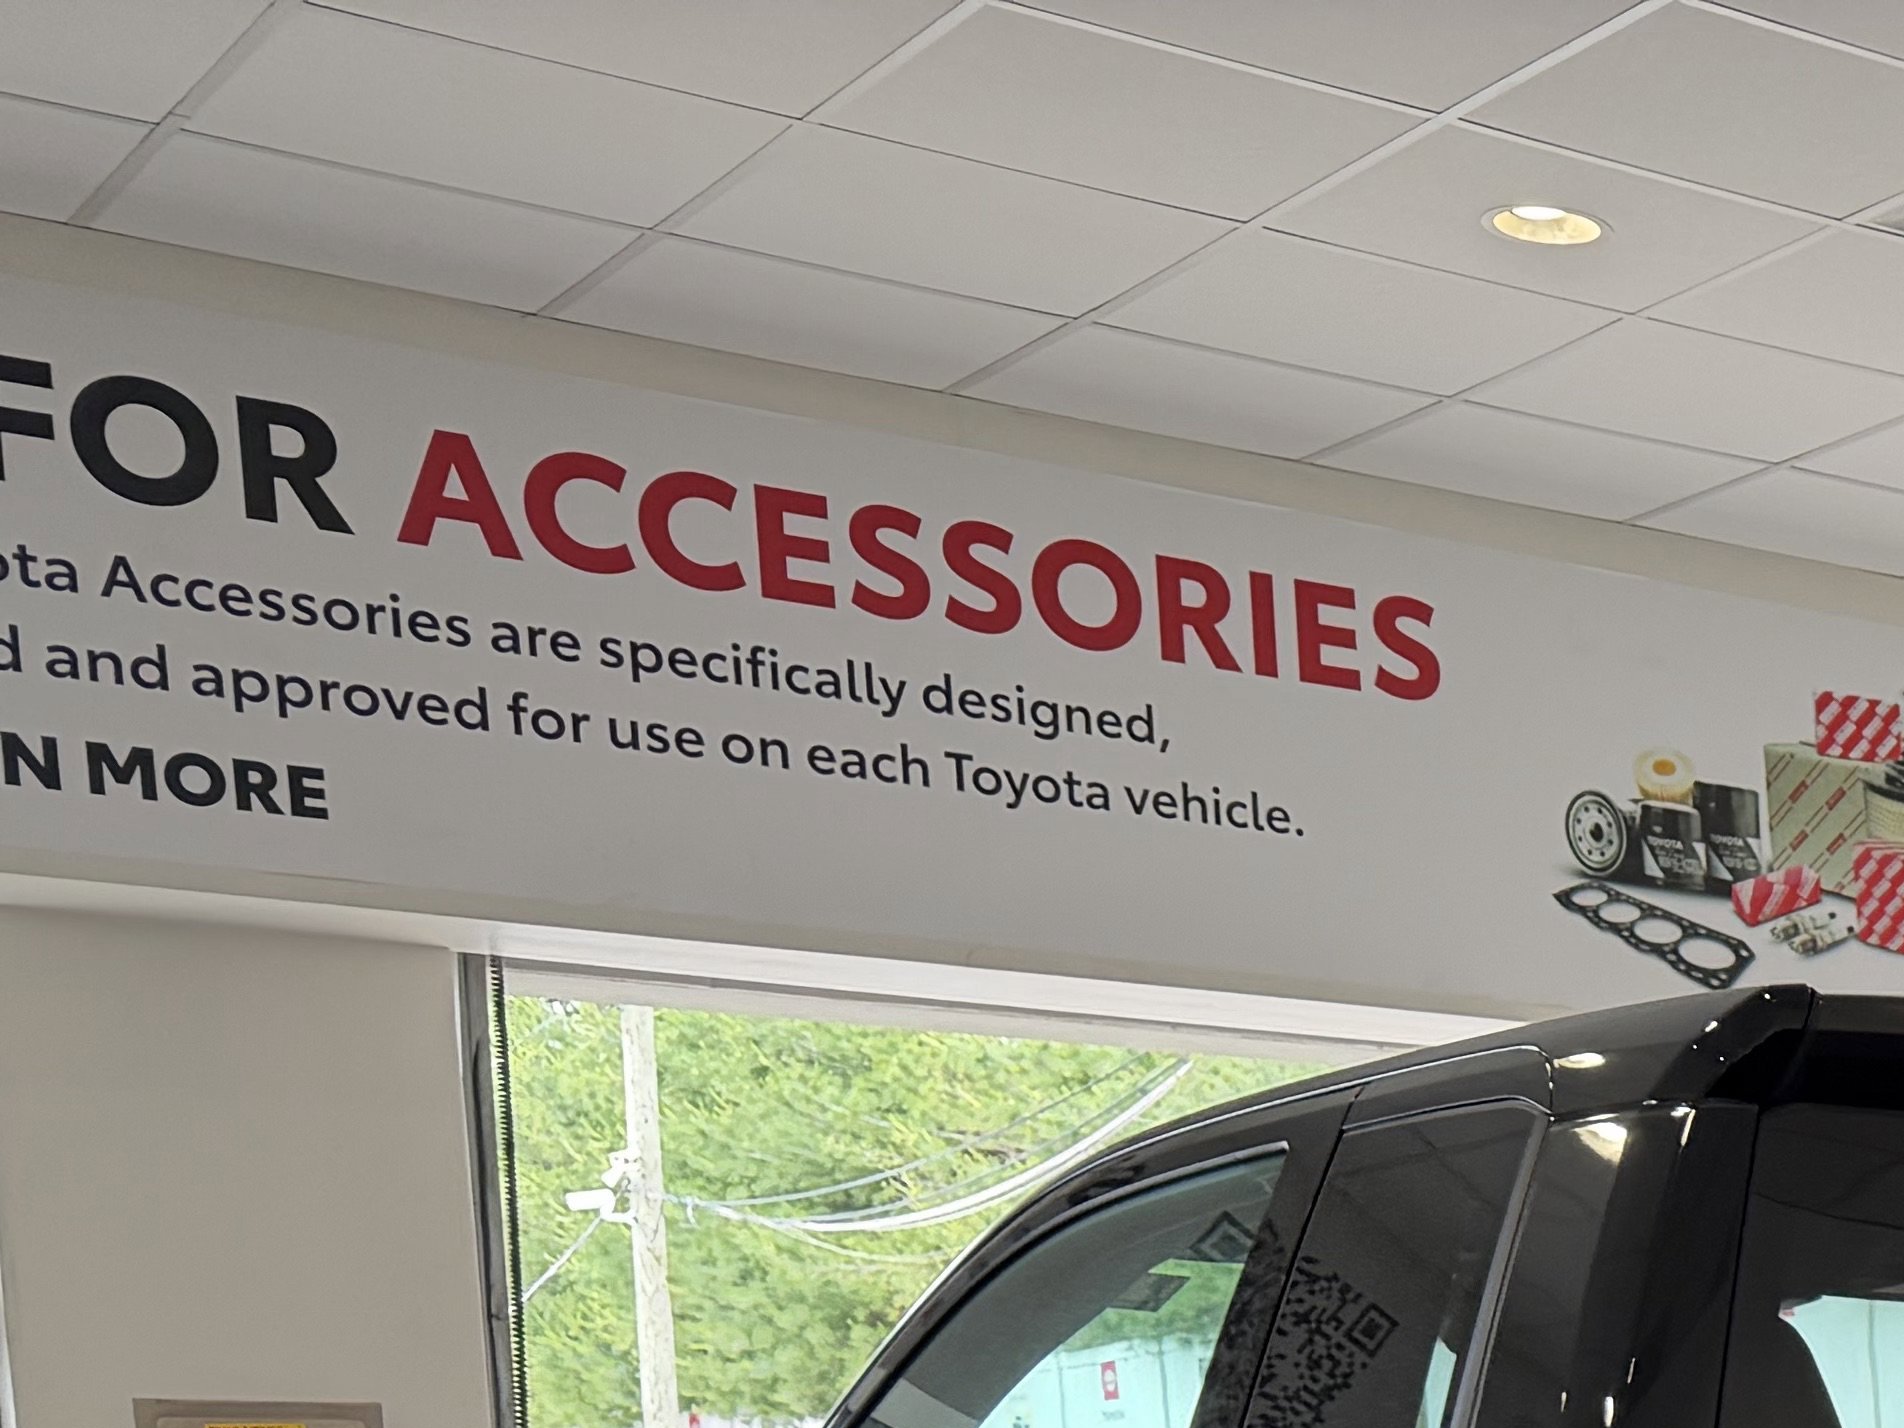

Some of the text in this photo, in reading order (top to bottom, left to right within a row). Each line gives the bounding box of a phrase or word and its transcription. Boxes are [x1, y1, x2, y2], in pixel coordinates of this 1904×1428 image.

[0, 354, 1442, 701] FOR ACCESSORIES
[46, 644, 170, 692] and
[192, 663, 490, 732] approved
[507, 692, 591, 744] for
[609, 718, 705, 759] use
[722, 734, 790, 770] on
[808, 743, 931, 788] each
[944, 751, 1111, 812] Toyota
[1124, 782, 1304, 837] vehicle.
[101, 555, 472, 648] Accessories
[491, 622, 582, 663] are
[600, 638, 907, 718] specifically
[923, 673, 1170, 754] designed,
[85, 741, 330, 821] MORE
